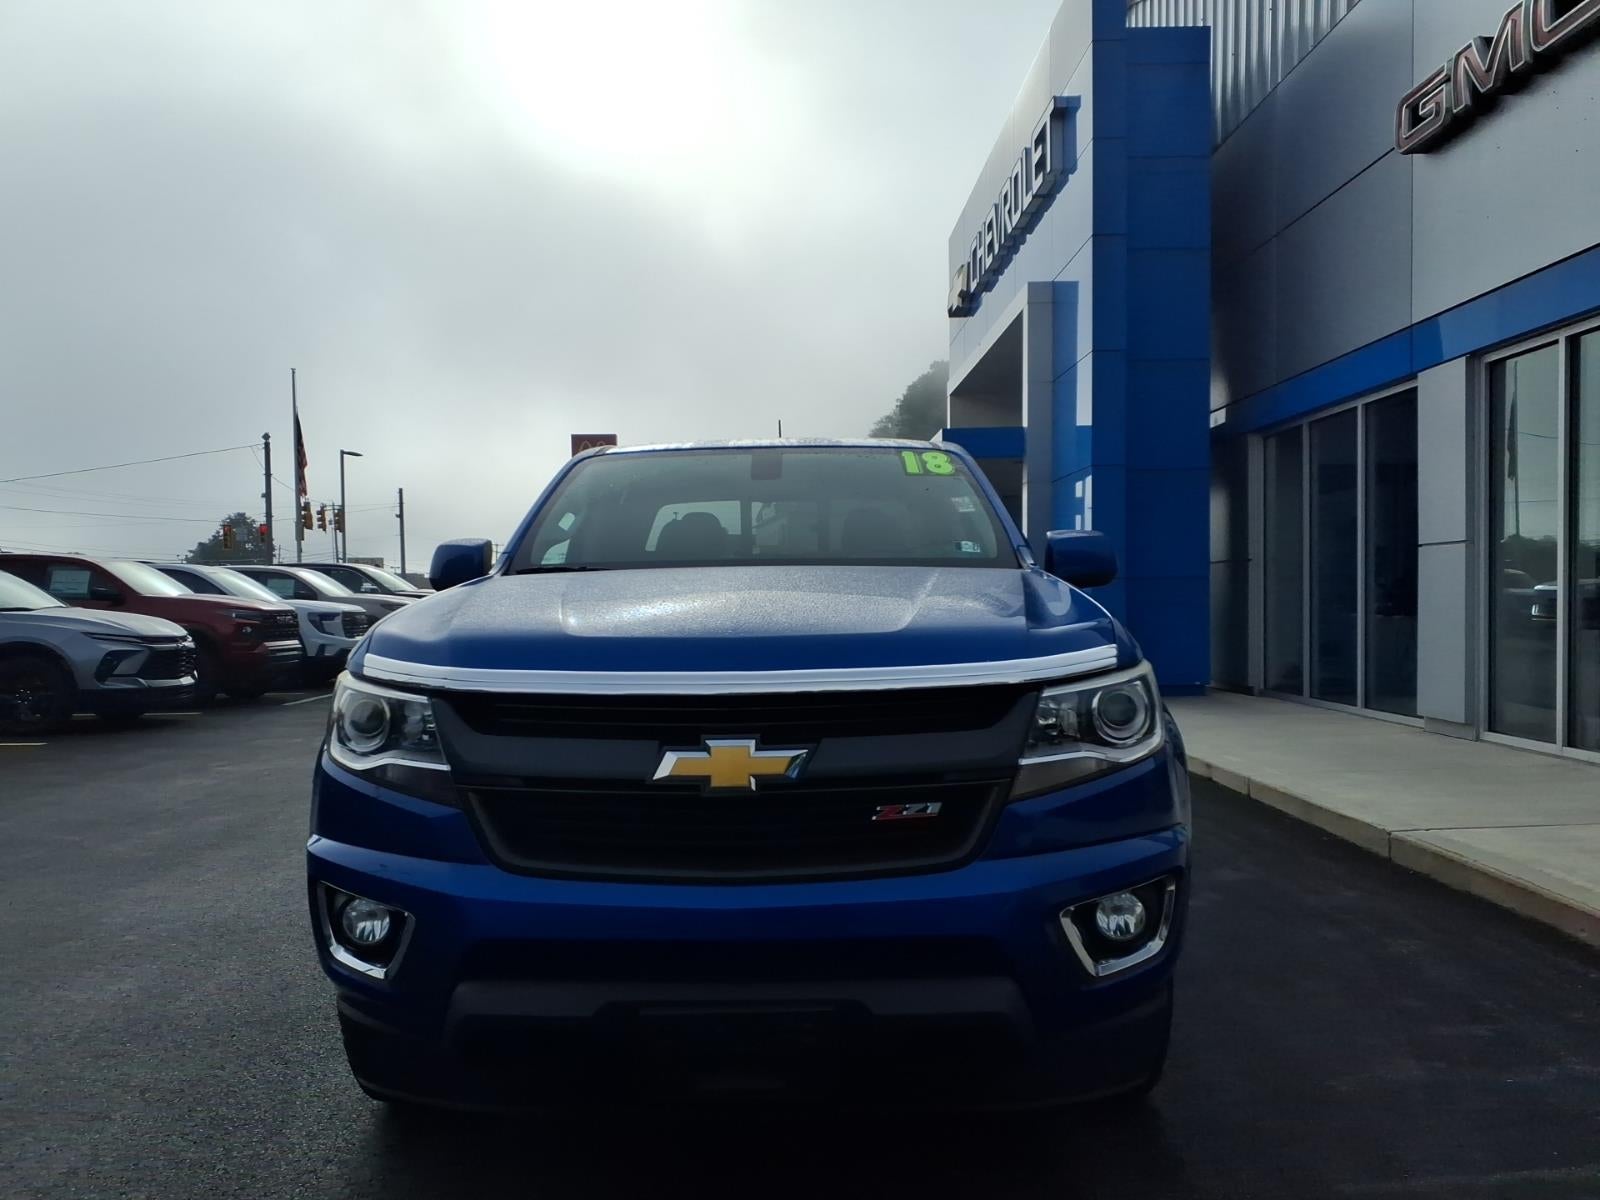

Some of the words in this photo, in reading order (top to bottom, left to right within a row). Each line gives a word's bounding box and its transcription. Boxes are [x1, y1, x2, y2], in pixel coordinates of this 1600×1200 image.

[968, 95, 1079, 295] CHEVROLET
[901, 451, 955, 475] 18
[872, 802, 942, 821] Z71
